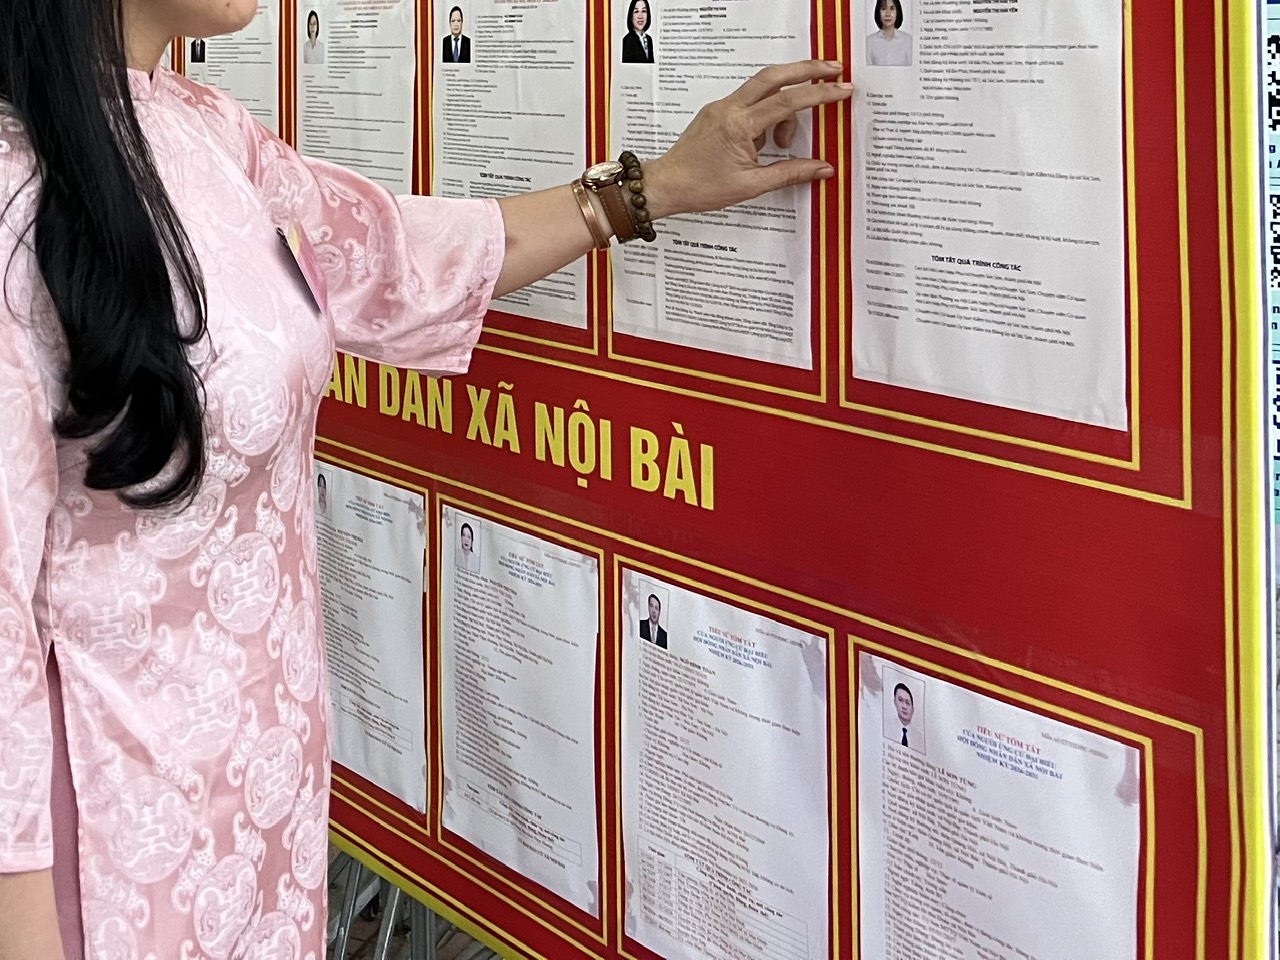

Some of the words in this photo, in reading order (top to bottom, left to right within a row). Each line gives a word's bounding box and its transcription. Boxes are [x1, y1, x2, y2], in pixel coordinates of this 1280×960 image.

[465, 380, 521, 454] XÃ
[534, 398, 612, 488] NỘI
[629, 421, 715, 511] BÀI
